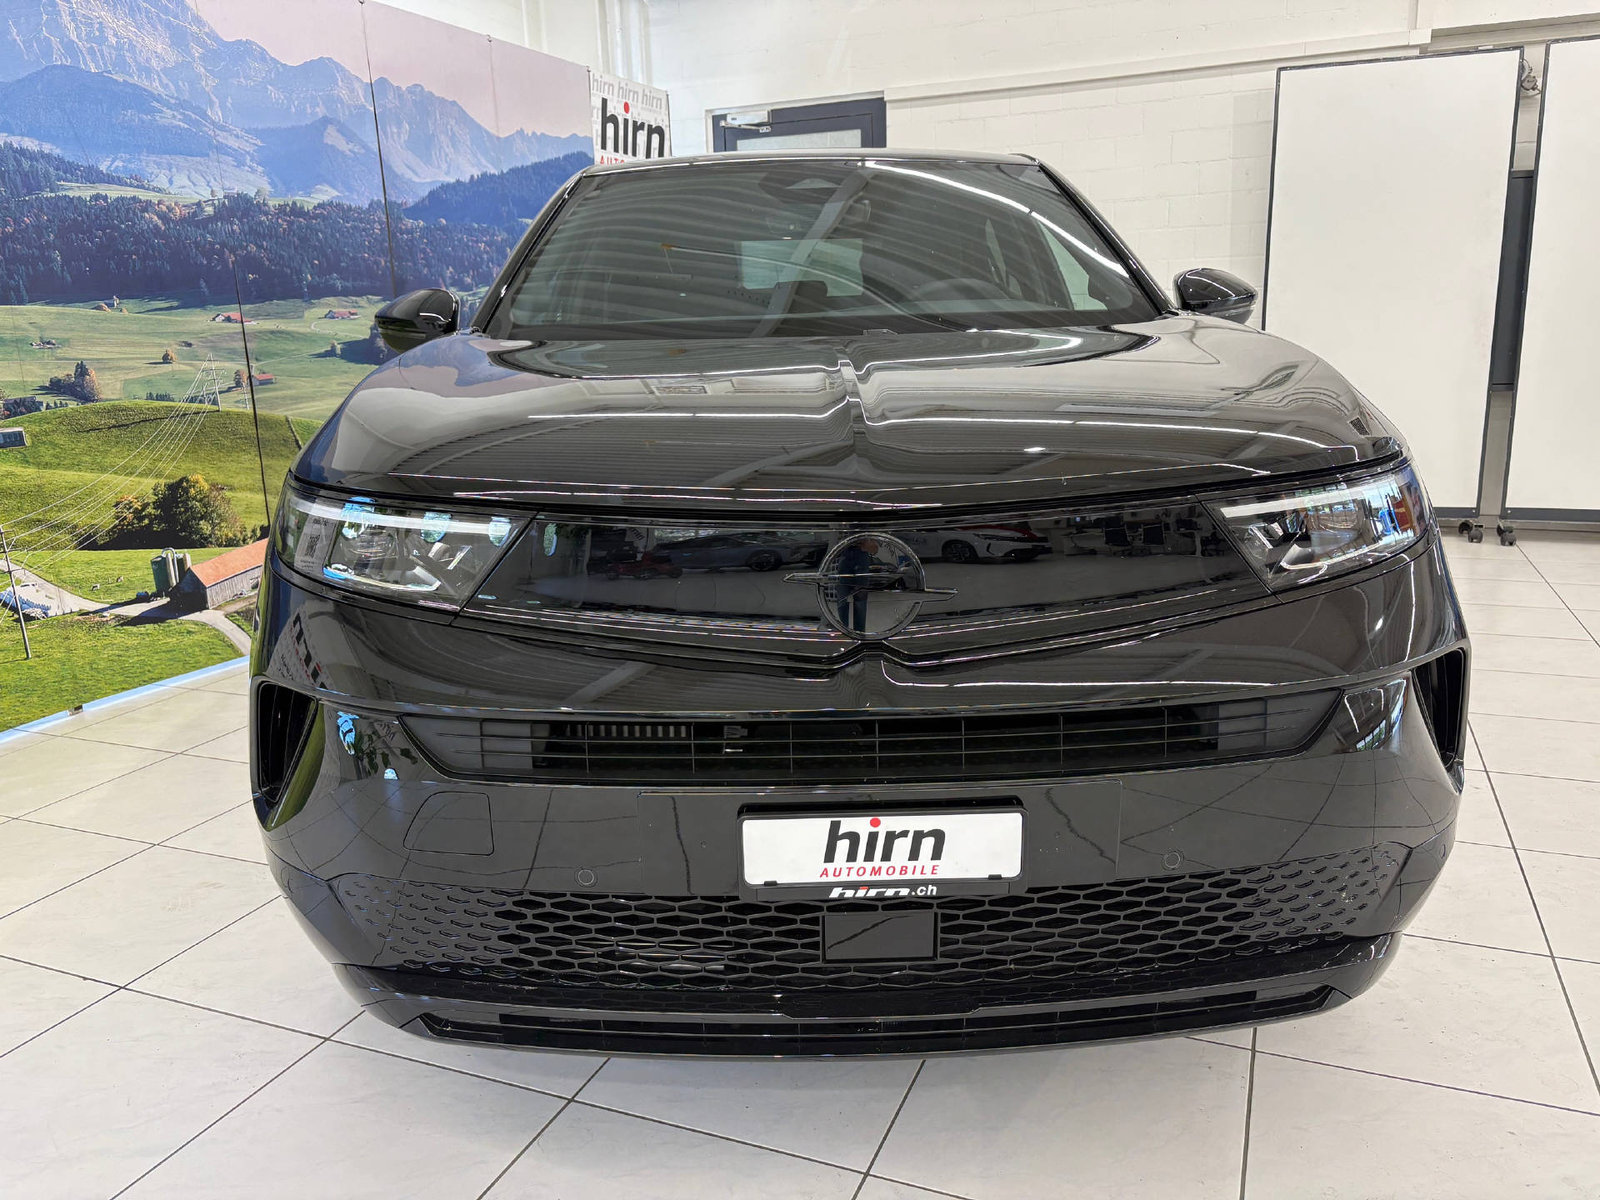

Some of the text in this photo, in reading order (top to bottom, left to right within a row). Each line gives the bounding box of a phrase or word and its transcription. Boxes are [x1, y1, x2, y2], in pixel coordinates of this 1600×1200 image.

[592, 74, 615, 96] hirn
[618, 81, 640, 103] hirn
[642, 89, 663, 111] hirn
[601, 97, 665, 159] hirn
[823, 817, 946, 863] hirn
[819, 864, 940, 878] AUTOMOBILE
[828, 884, 937, 898] hirn.ch
